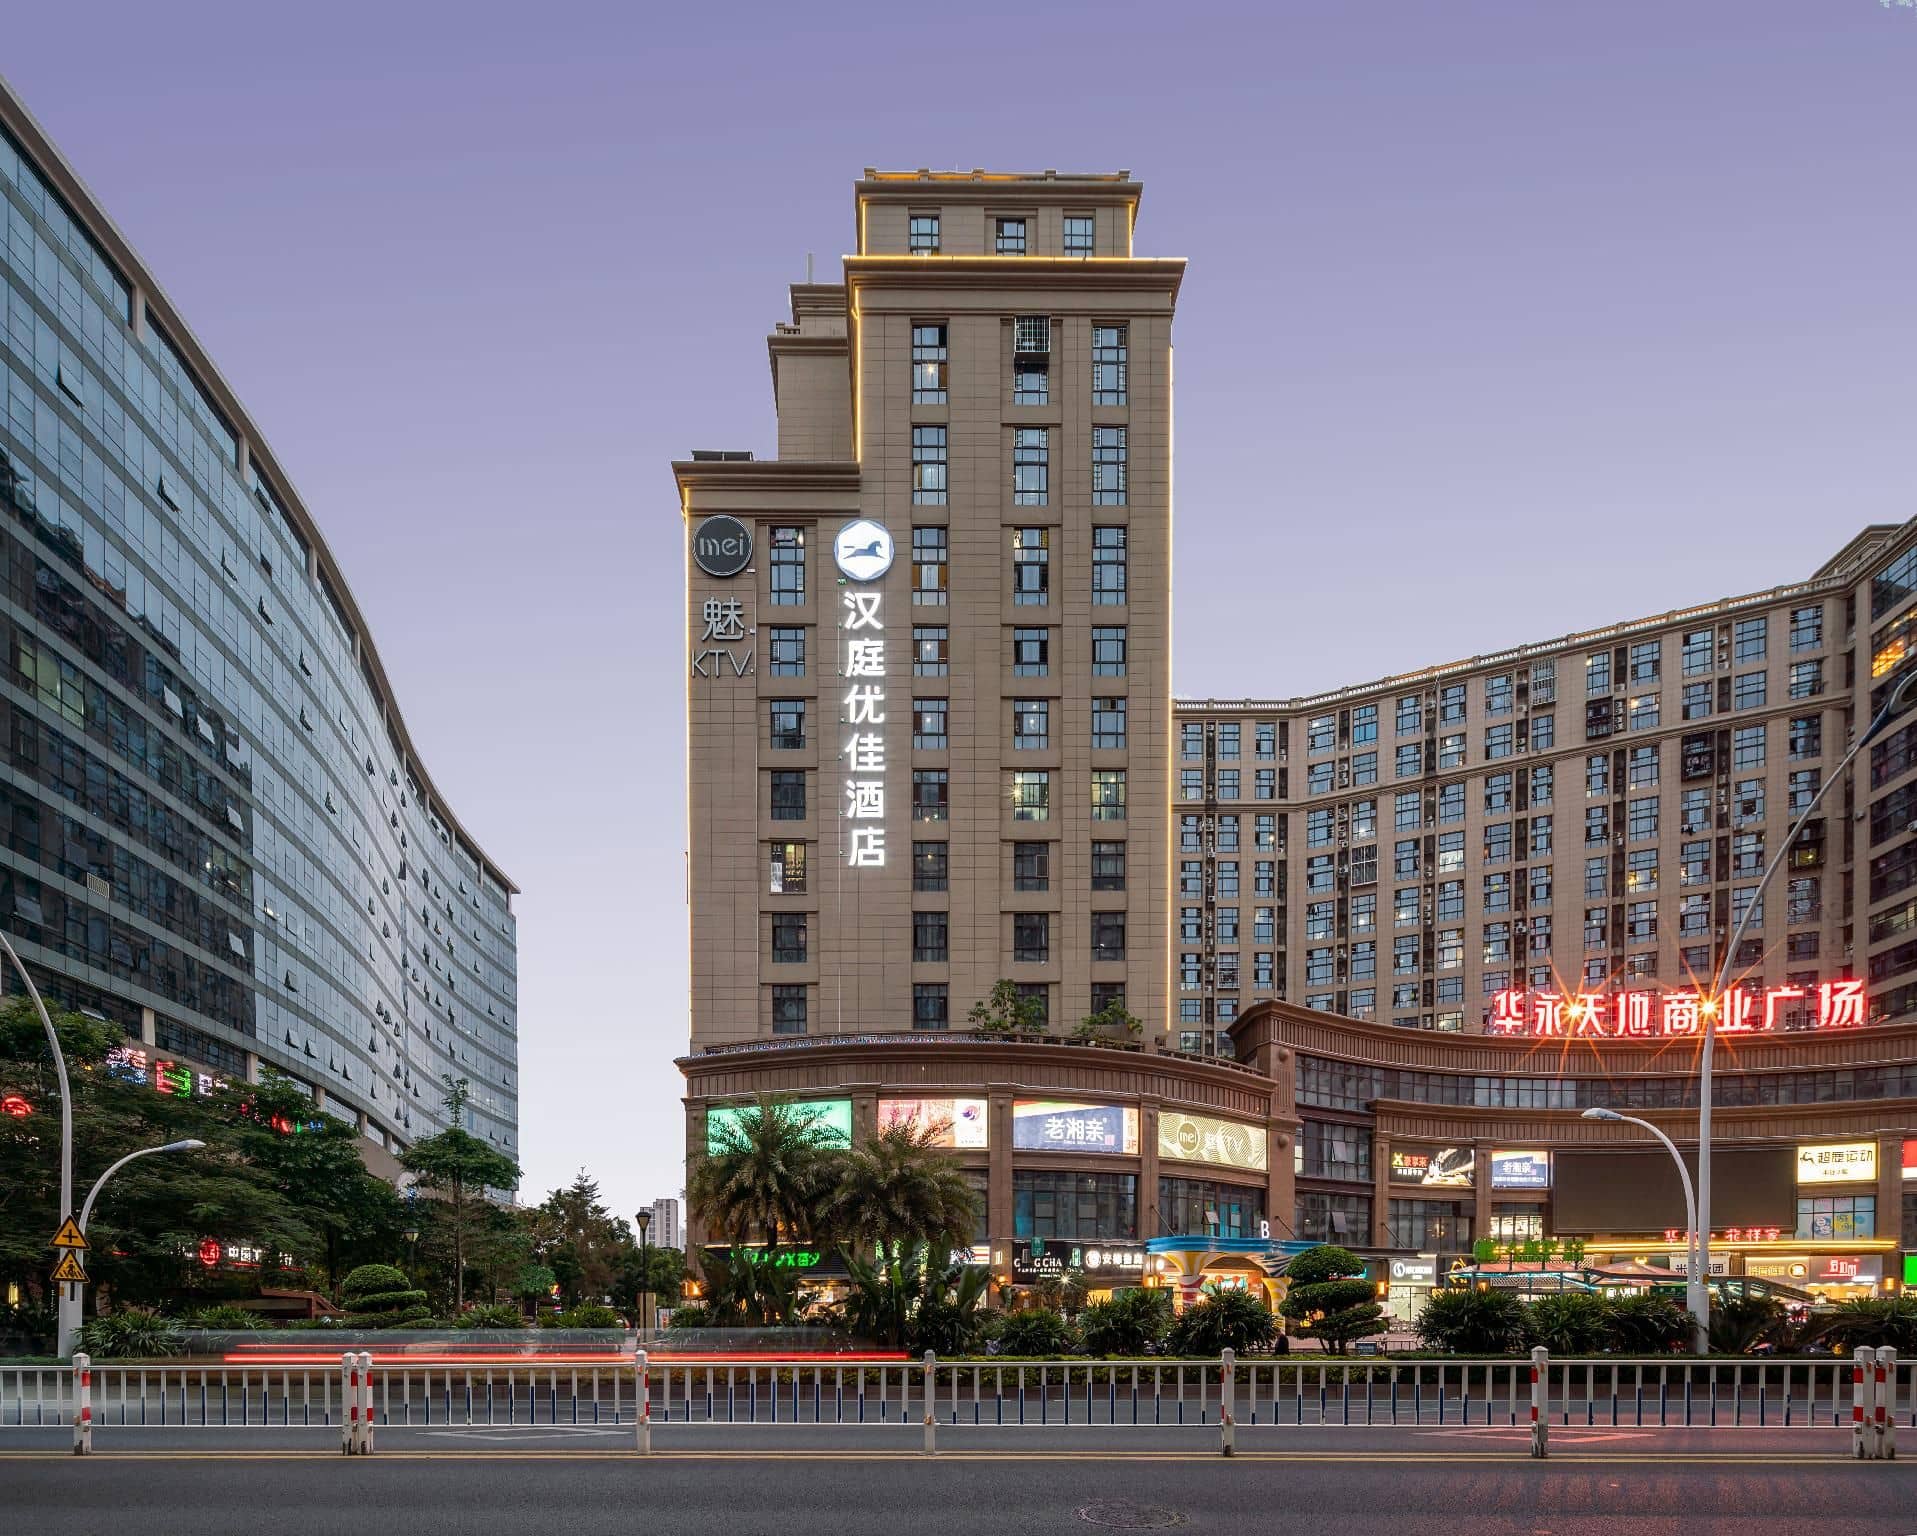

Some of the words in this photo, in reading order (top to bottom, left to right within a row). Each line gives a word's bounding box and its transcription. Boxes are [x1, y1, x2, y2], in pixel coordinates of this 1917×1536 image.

[699, 534, 744, 556] mei
[702, 596, 745, 641] 魅
[691, 649, 751, 677] KTV
[844, 591, 887, 868] 汉庭优佳酒店
[1494, 980, 1866, 1035] 华永天地商业广场
[1045, 1116, 1104, 1141] 老湘亲
[1261, 1221, 1269, 1238] B
